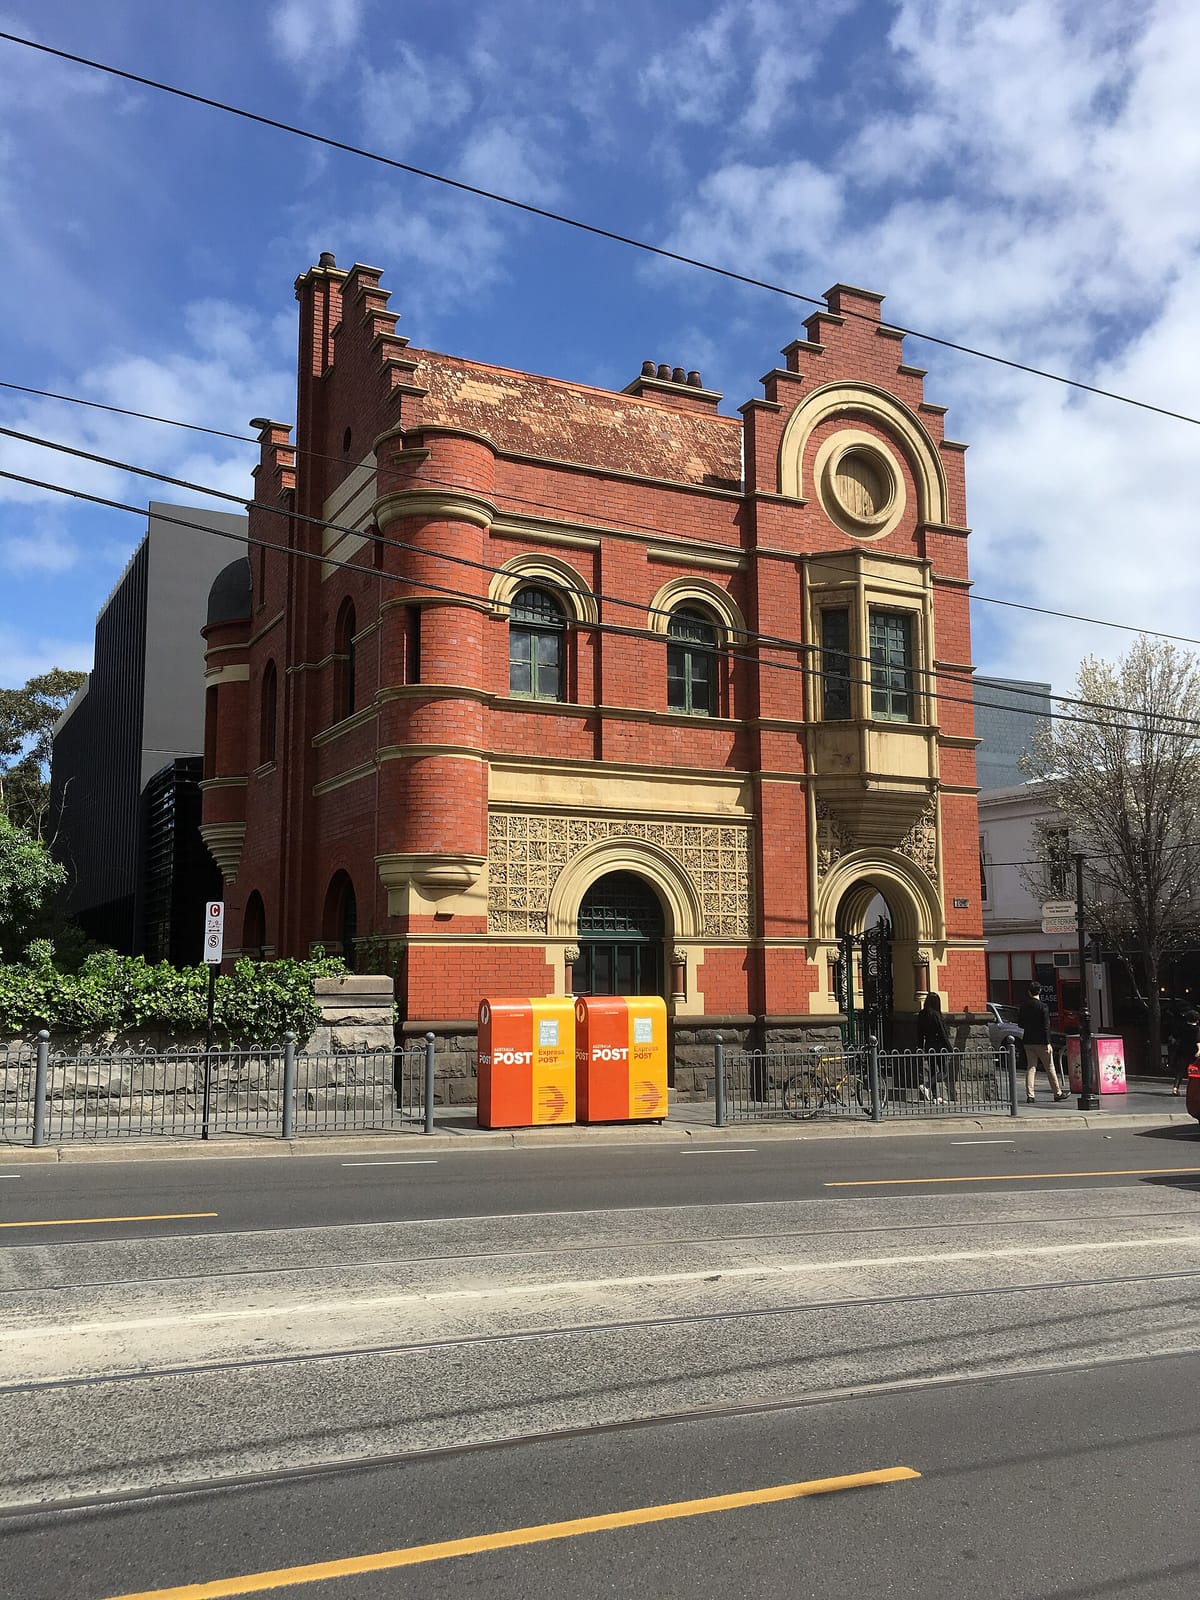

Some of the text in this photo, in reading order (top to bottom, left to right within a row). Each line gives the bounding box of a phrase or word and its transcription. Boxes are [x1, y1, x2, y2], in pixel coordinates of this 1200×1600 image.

[479, 1054, 491, 1065] POST
[493, 1051, 533, 1065] POST
[575, 1051, 589, 1061] POST
[592, 1048, 629, 1062] POST
